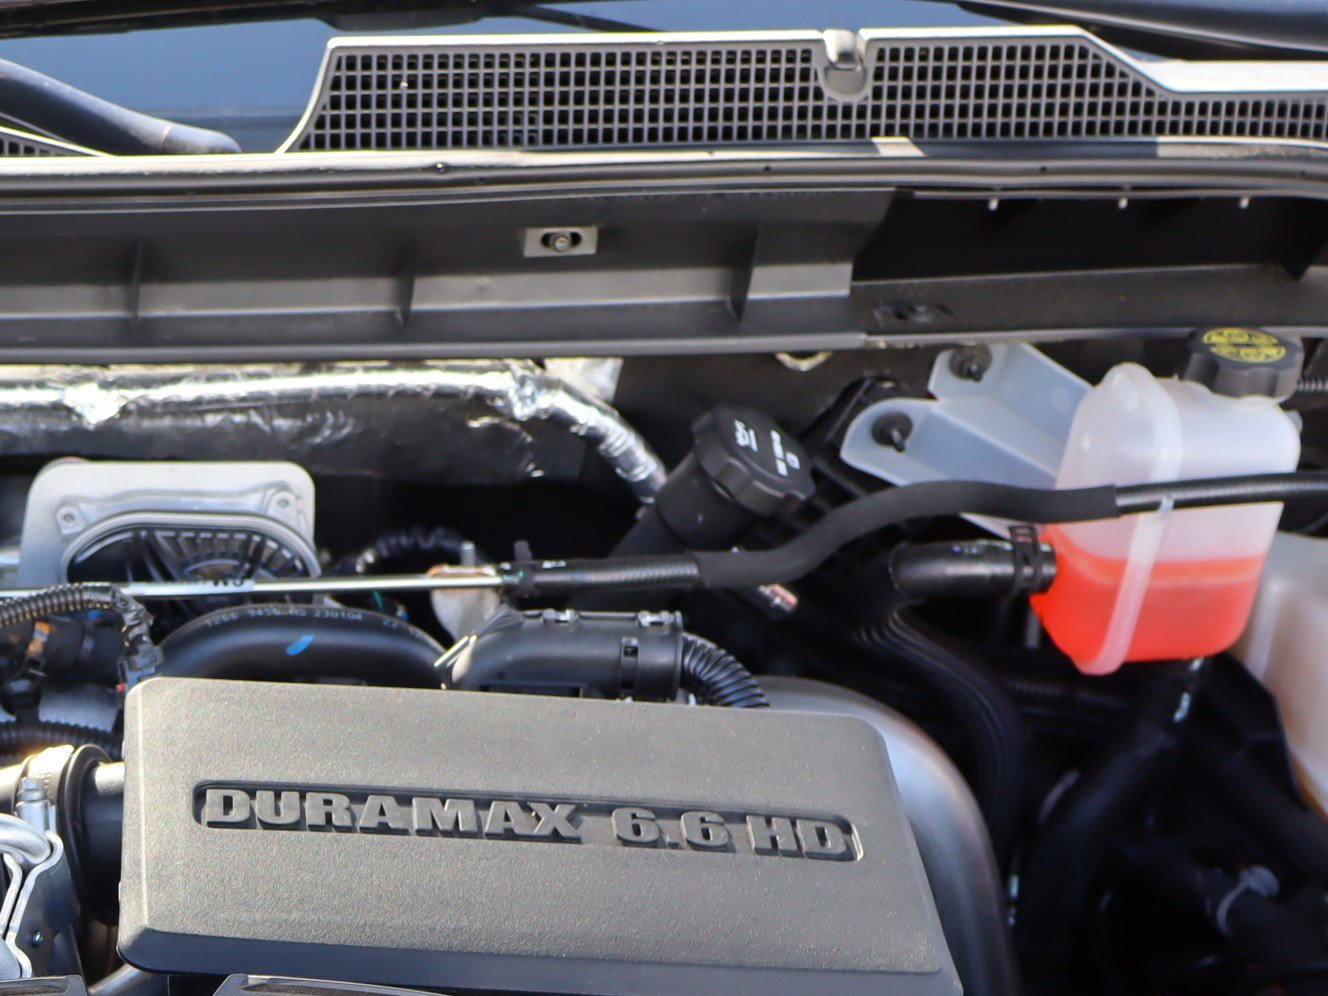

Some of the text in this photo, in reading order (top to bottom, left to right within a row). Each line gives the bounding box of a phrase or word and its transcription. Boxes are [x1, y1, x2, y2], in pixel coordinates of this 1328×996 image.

[205, 788, 849, 858] DURAMAX 6.6 HD
